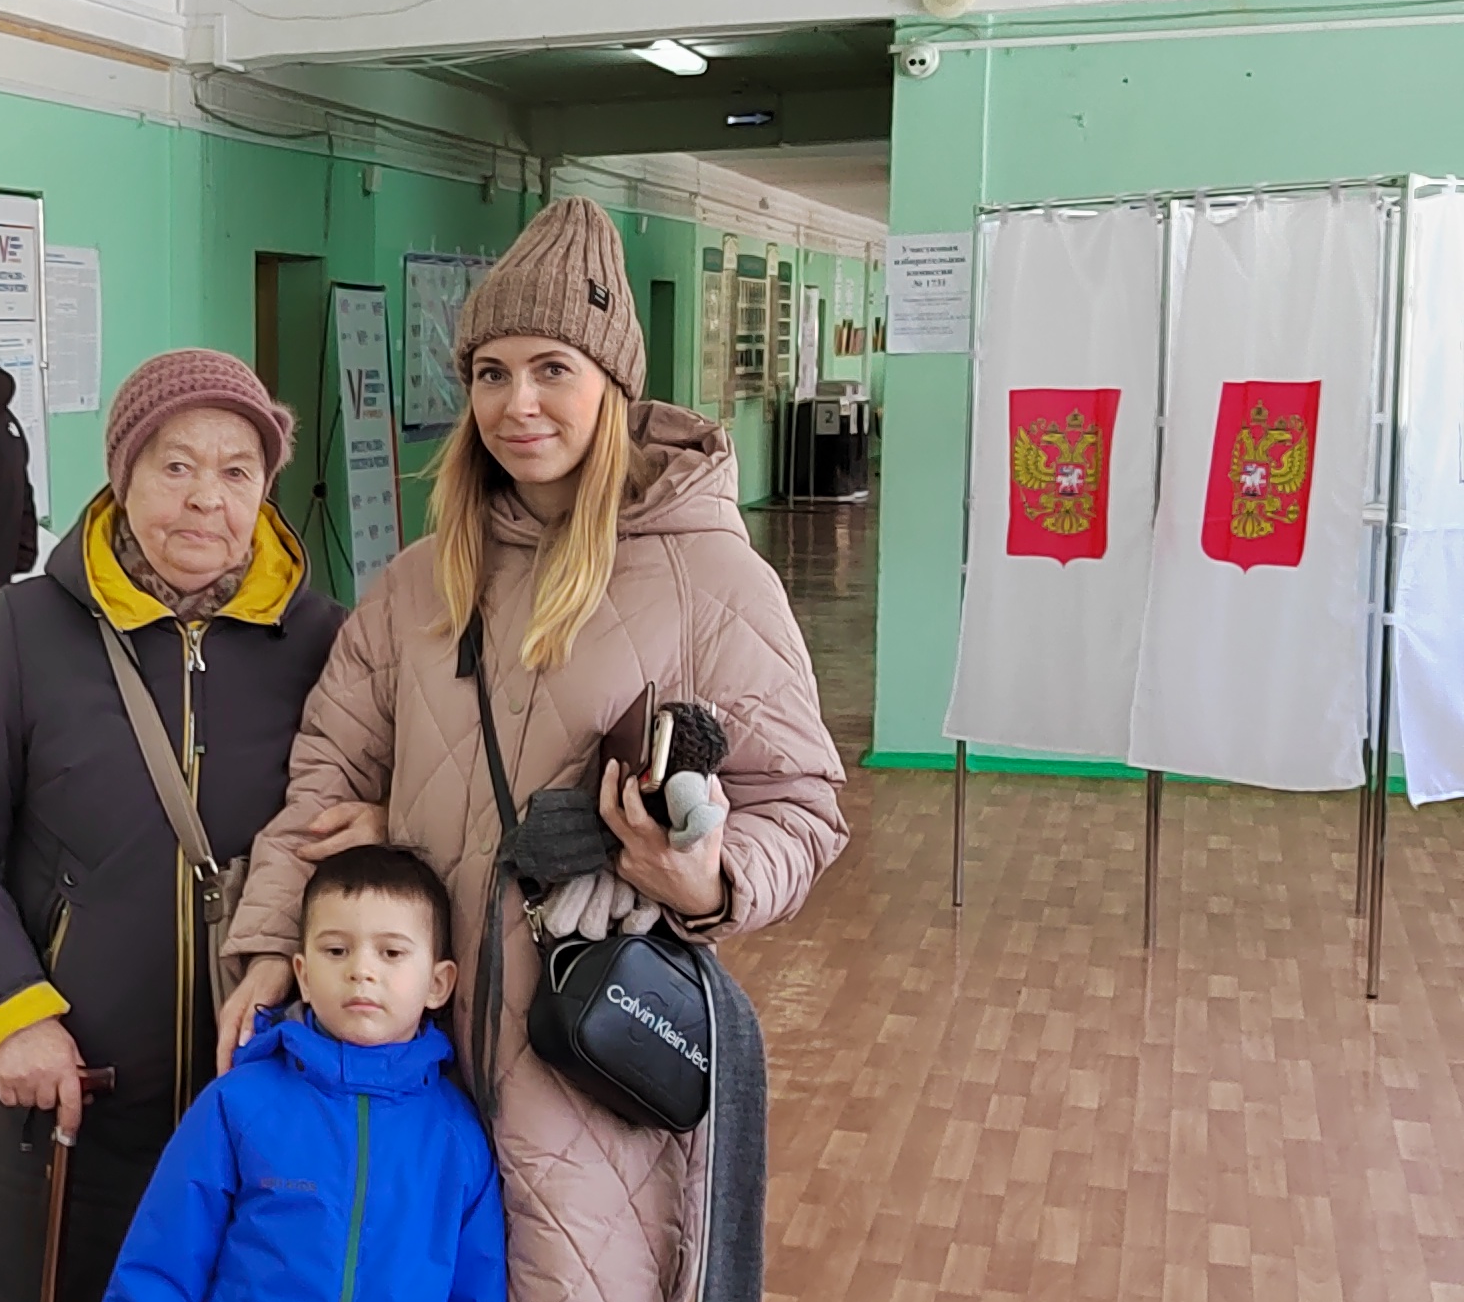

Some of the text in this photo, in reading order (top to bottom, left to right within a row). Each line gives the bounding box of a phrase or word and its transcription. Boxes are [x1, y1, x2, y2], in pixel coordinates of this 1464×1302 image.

[825, 410, 834, 424] 2
[606, 984, 709, 1073] Calvin Klein Jea
